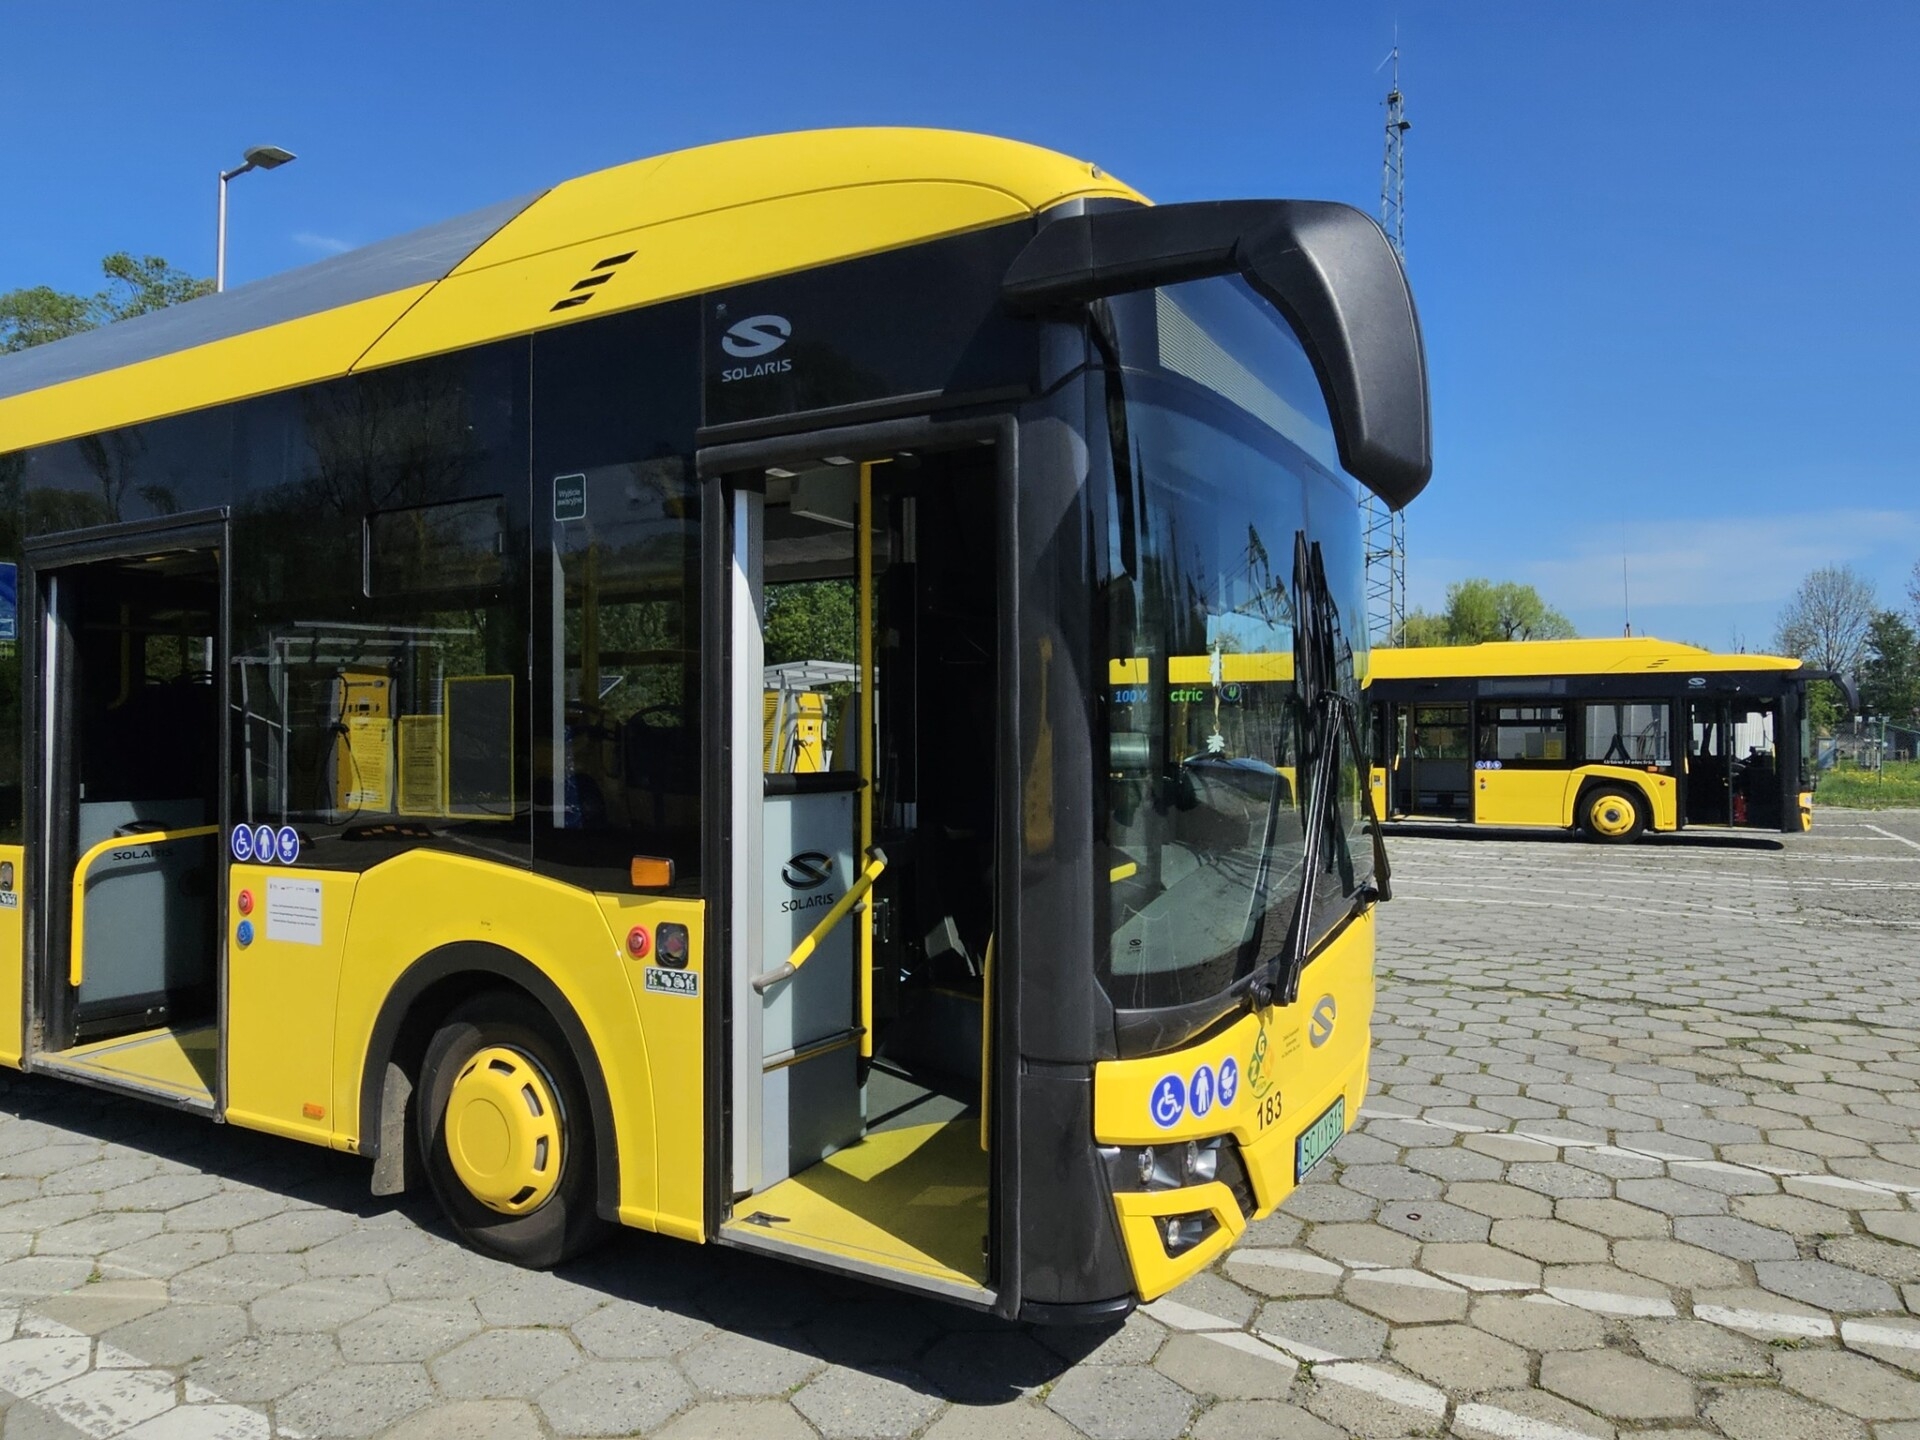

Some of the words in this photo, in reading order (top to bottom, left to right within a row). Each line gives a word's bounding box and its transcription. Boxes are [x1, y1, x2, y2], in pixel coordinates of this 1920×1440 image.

[721, 359, 792, 382] SOLARIS
[1115, 690, 1148, 703] 100%
[1170, 689, 1204, 702] ctric
[781, 893, 834, 913] SOLARIS
[1257, 1090, 1282, 1131] 183
